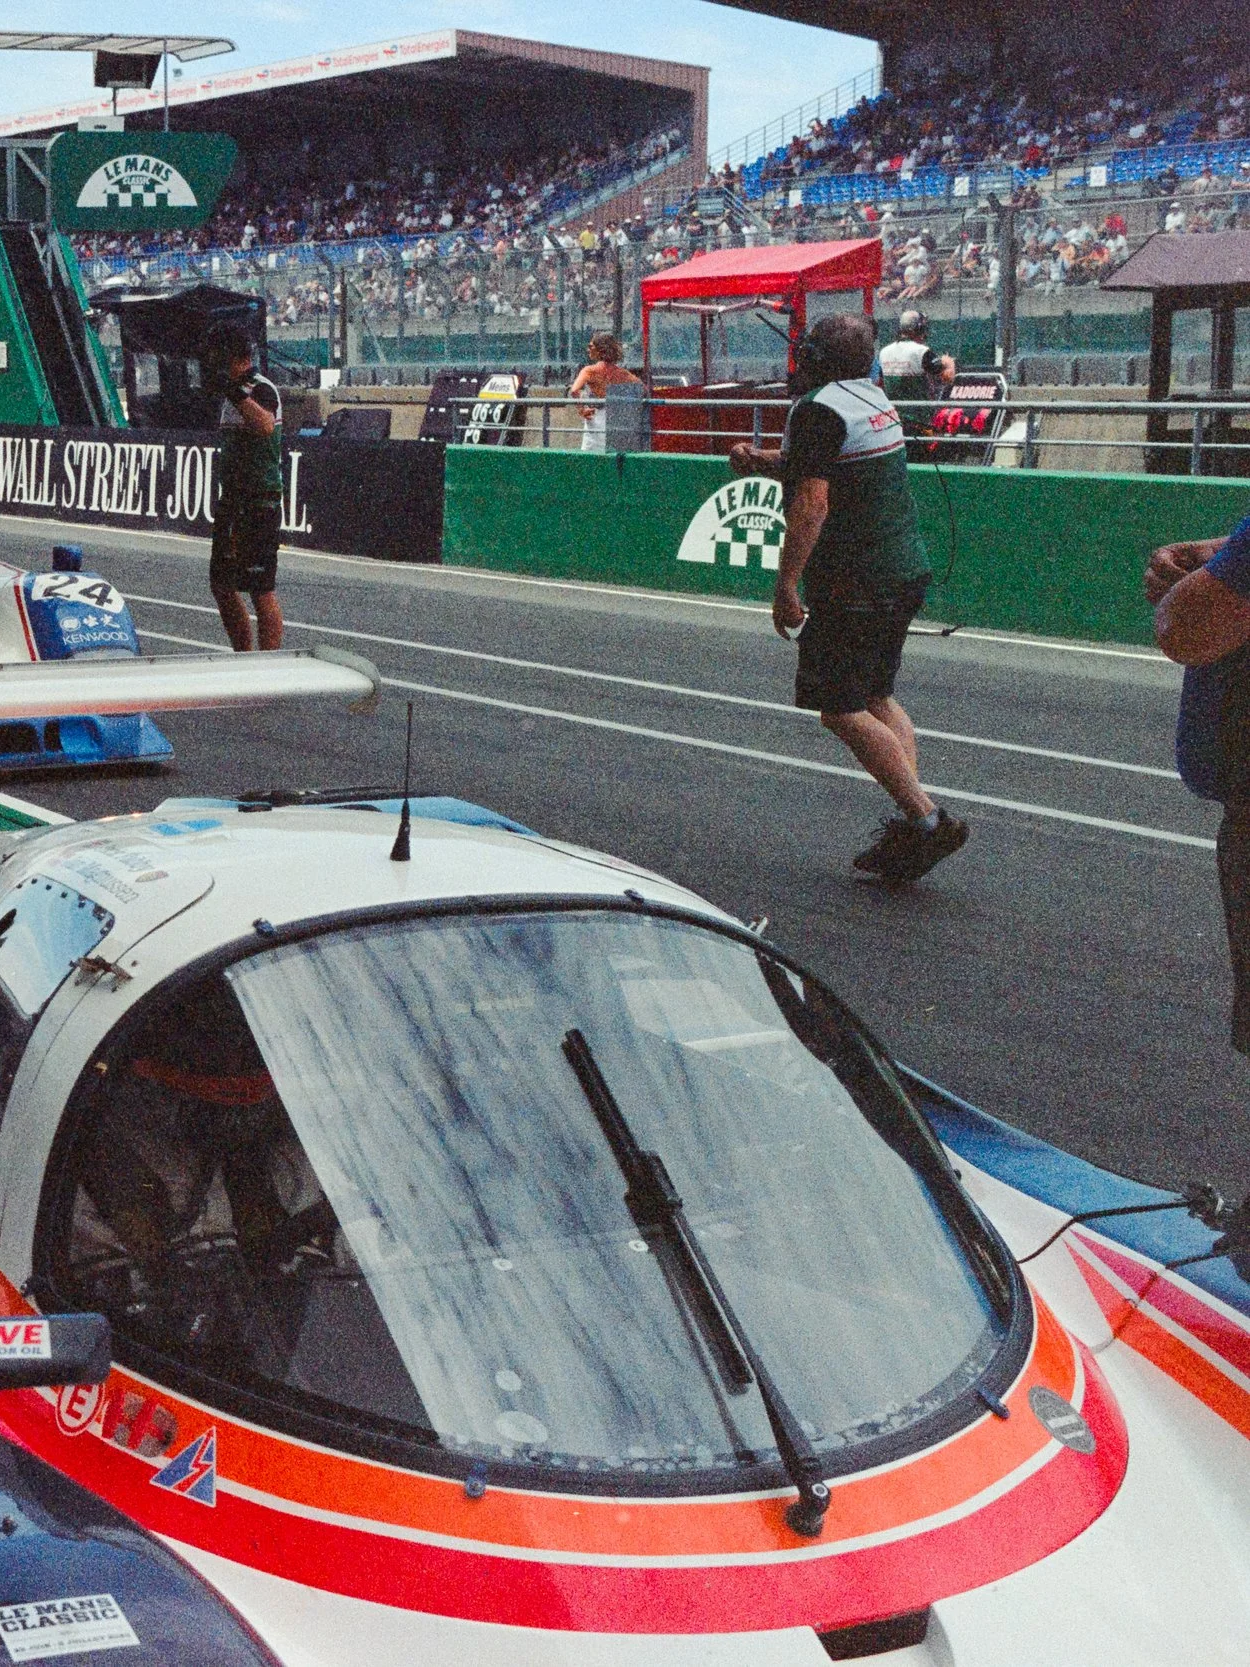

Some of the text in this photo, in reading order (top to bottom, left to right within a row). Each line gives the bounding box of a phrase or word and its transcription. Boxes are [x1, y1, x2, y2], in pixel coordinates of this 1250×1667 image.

[103, 157, 173, 182] LE MANS
[61, 440, 165, 517] STREET
[714, 481, 784, 520] LE MA
[737, 513, 776, 531] CLASSIC
[43, 576, 113, 607] 24
[62, 631, 129, 645] KENWOOD
[20, 1346, 43, 1355] OIL
[65, 1384, 95, 1420] E
[33, 1598, 113, 1616] MANS
[1, 1608, 119, 1633] CLASSIC
